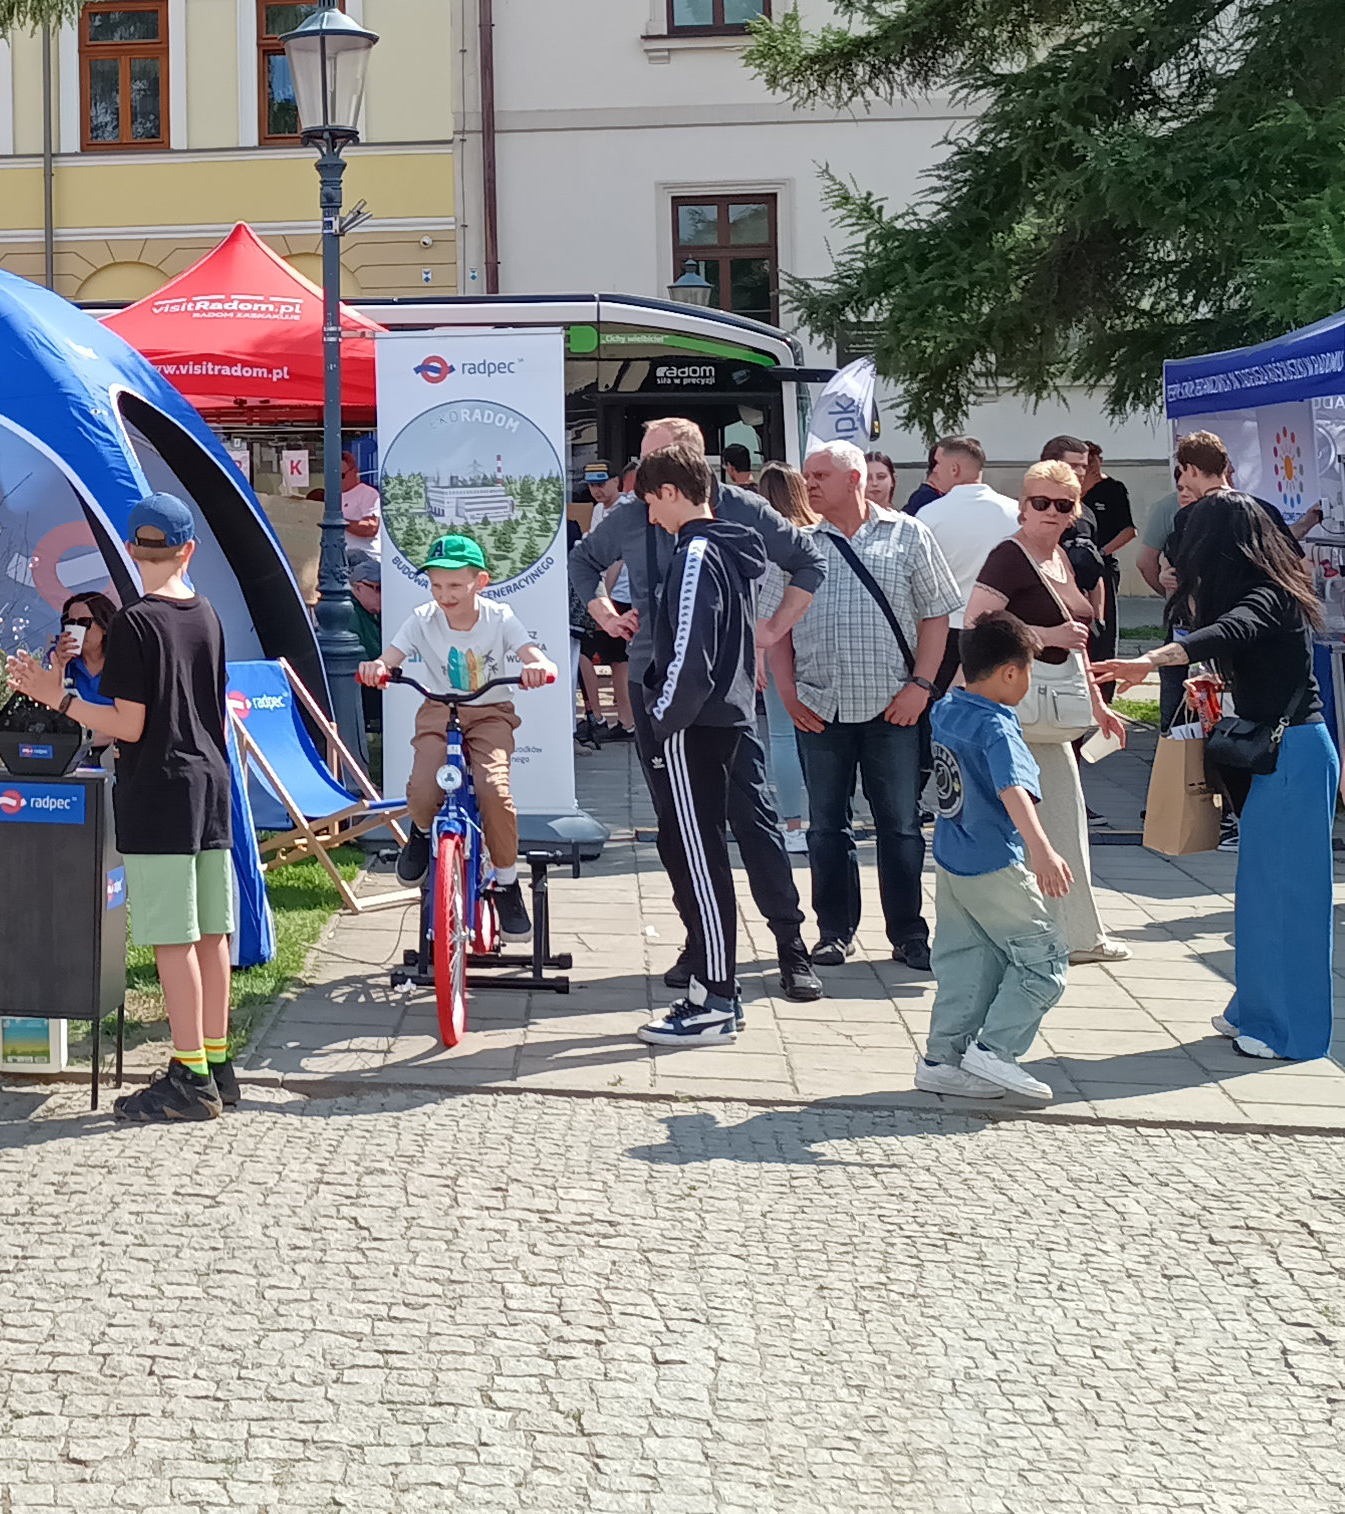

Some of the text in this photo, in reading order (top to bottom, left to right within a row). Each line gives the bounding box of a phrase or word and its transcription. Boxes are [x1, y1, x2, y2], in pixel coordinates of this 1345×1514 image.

[461, 360, 515, 377] radpec
[290, 460, 303, 476] K
[430, 542, 446, 558] A
[30, 795, 71, 811] radpec
